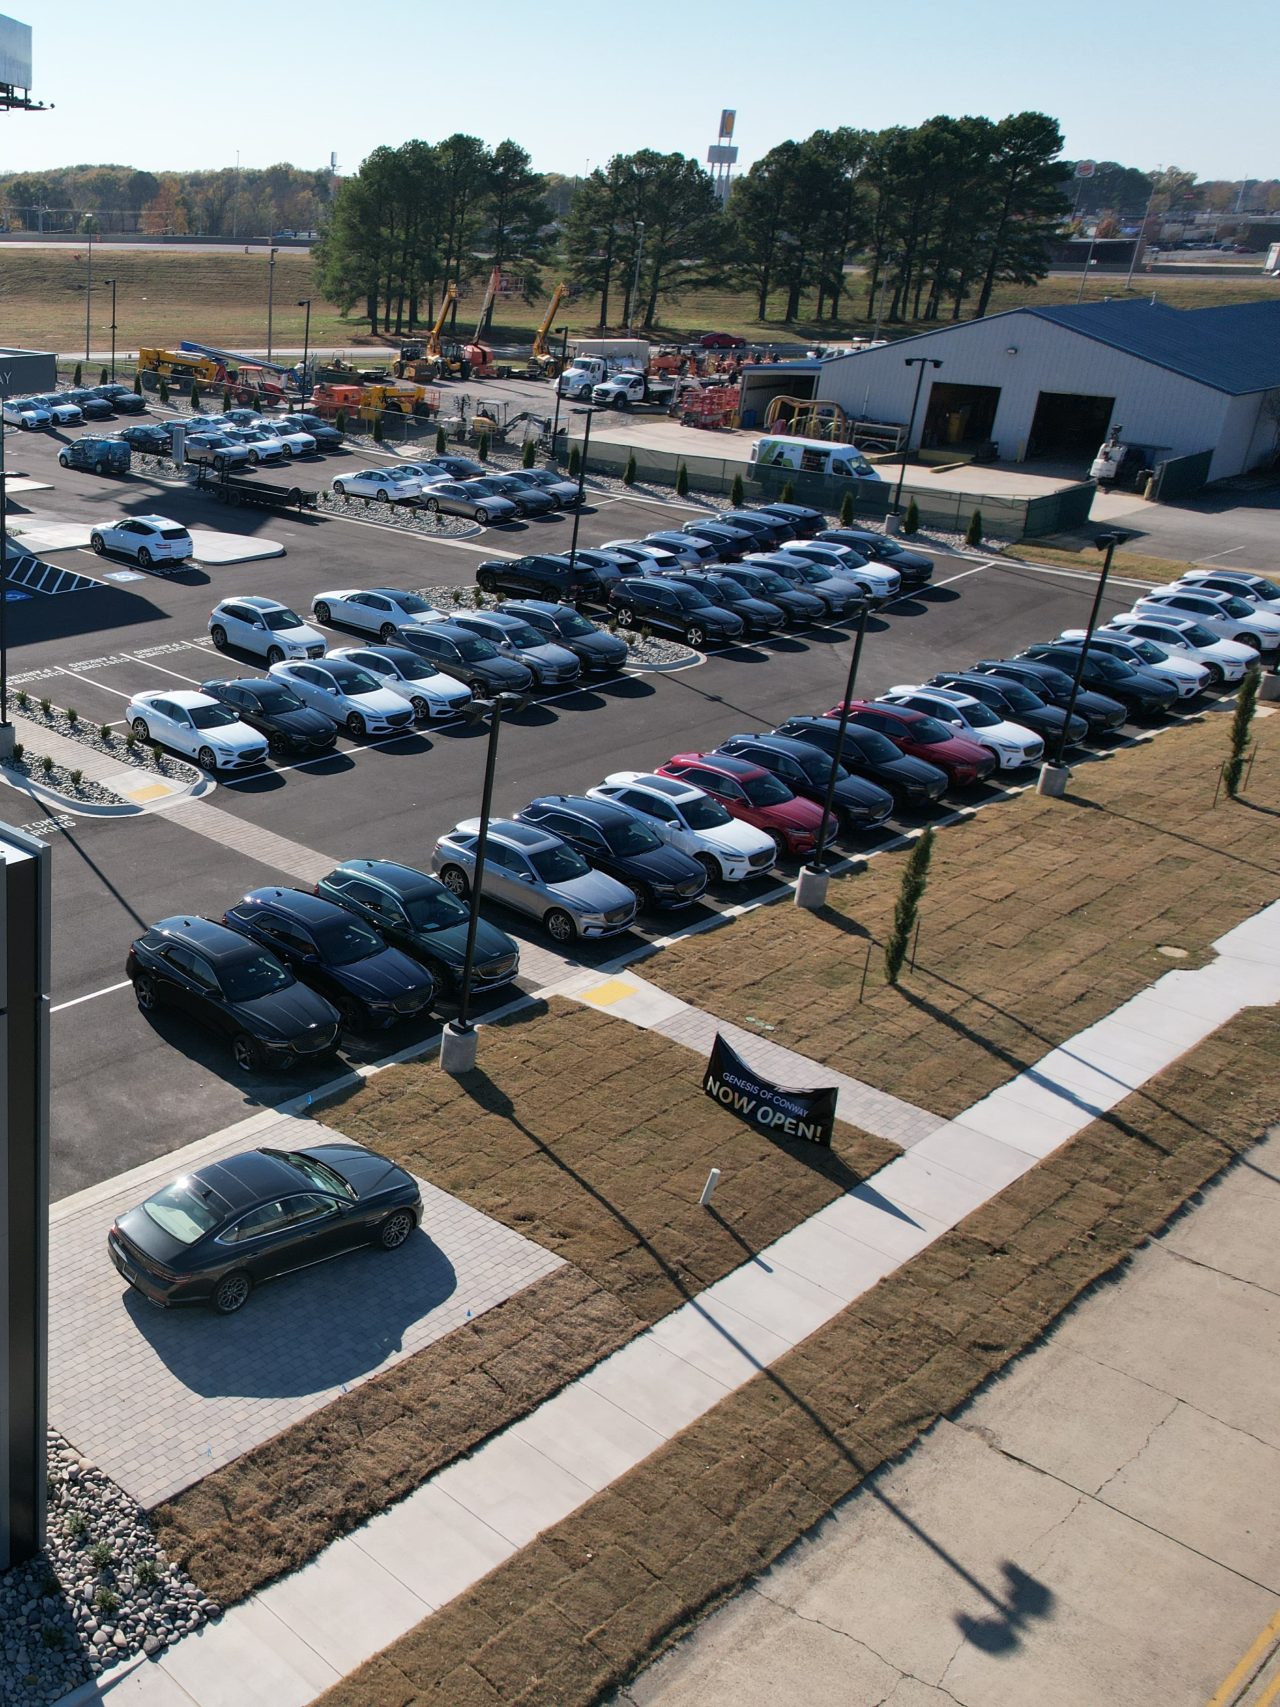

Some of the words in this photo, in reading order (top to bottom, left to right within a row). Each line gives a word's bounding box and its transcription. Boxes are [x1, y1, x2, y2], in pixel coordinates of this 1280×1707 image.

[17, 814, 73, 832] TOMER
[30, 820, 77, 837] RKING
[706, 1076, 756, 1114] NOW
[757, 1106, 823, 1142] OPEN!
[722, 1072, 760, 1094] GENESIS
[760, 1089, 774, 1101] OF
[773, 1095, 809, 1117] CONWAY
